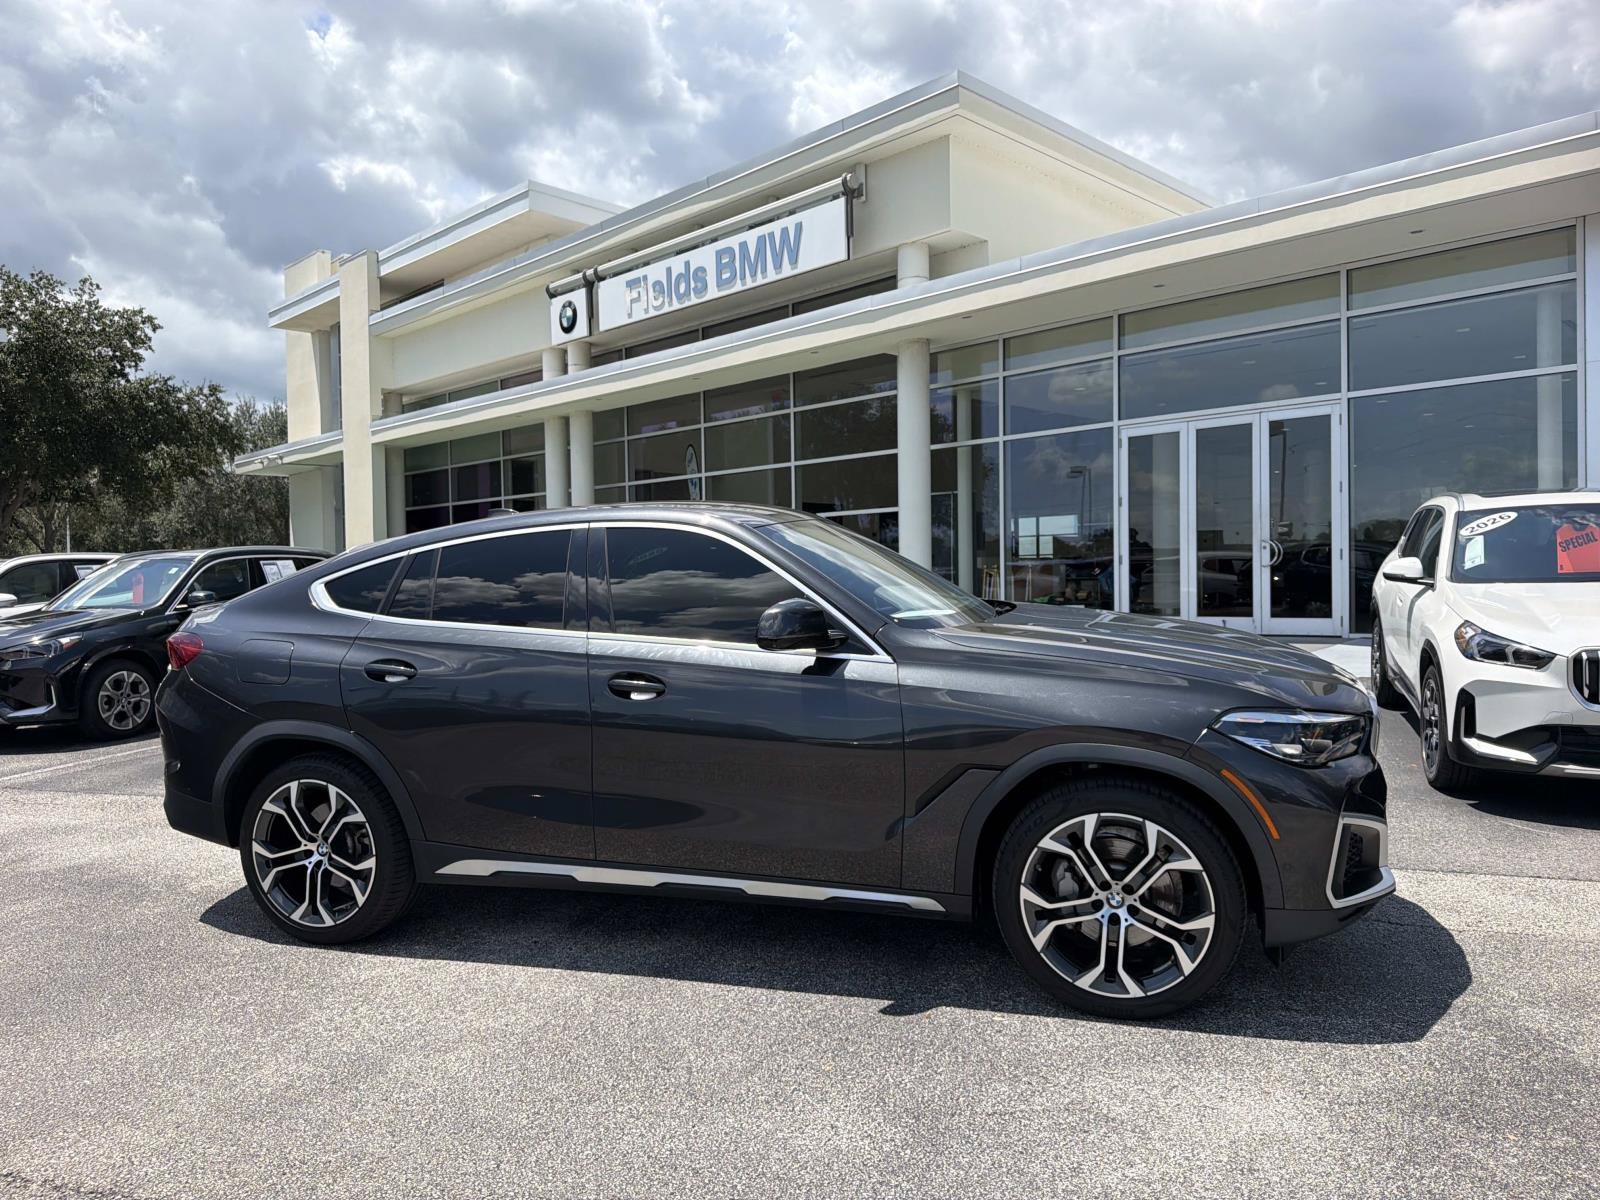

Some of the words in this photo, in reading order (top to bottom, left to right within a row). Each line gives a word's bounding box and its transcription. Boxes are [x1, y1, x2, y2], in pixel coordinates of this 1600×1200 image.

[625, 260, 708, 319] Fields
[715, 222, 803, 291] BMW
[1465, 513, 1512, 534] 2026
[1559, 531, 1598, 552] SPECIAL
